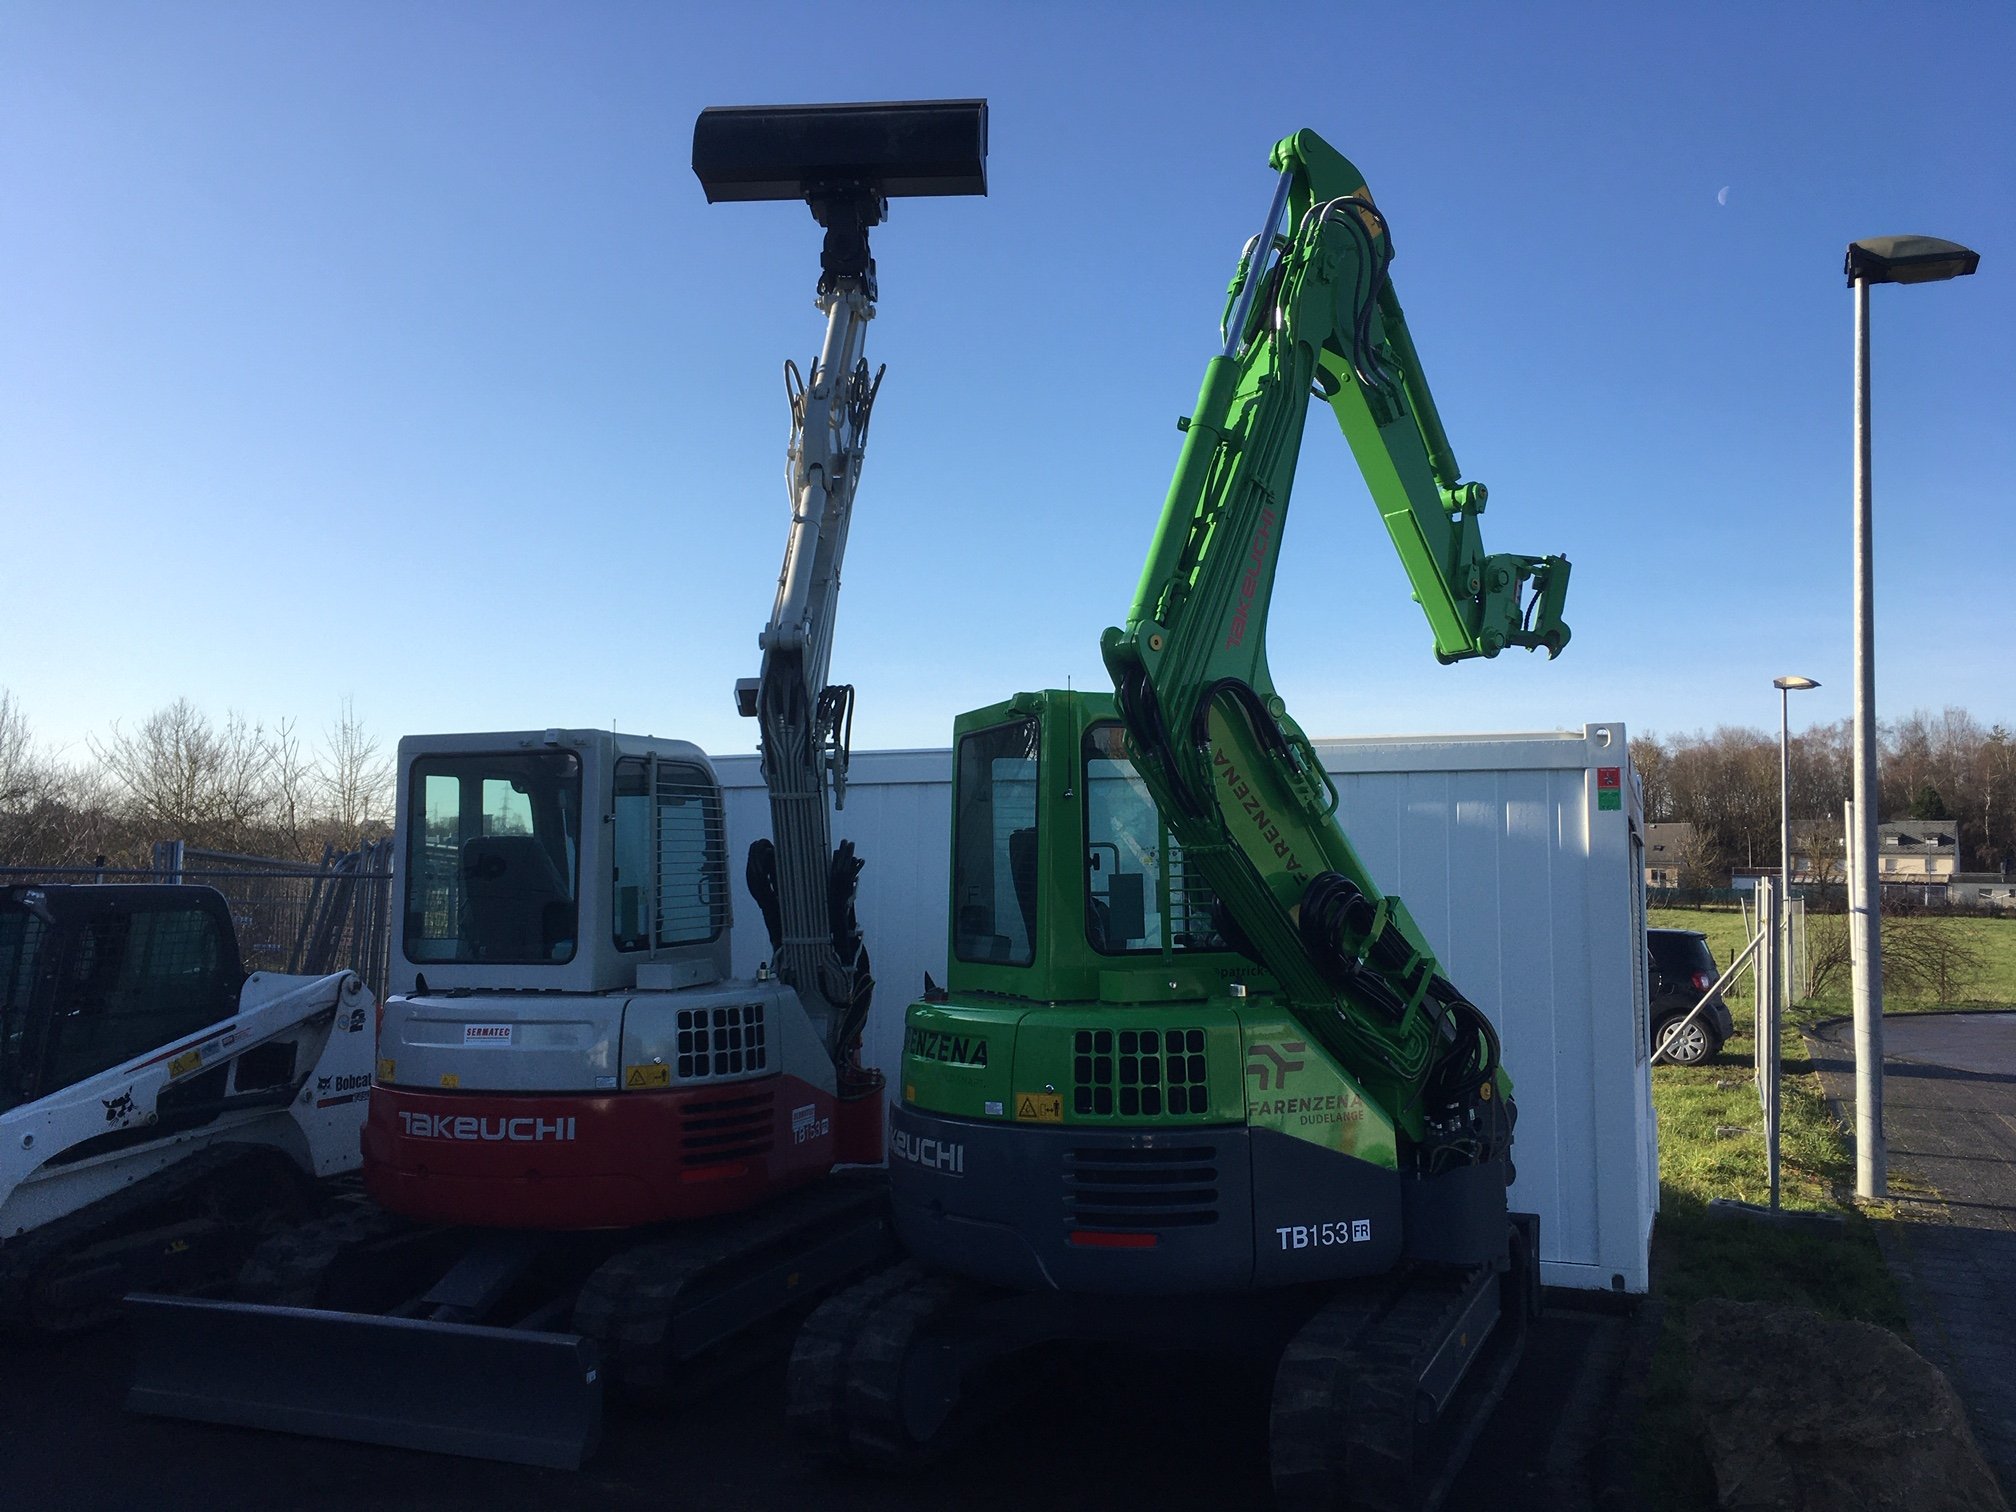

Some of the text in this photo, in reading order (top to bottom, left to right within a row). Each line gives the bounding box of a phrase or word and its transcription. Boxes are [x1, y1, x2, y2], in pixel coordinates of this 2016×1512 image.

[1213, 747, 1309, 887] FARENZENA
[466, 1027, 510, 1037] SERMATEC
[336, 1073, 372, 1092] Bobcat
[1249, 1094, 1363, 1117] FARENZENA
[1299, 1110, 1364, 1126] DUDELANGE
[1276, 1222, 1370, 1251] TB153 FR
